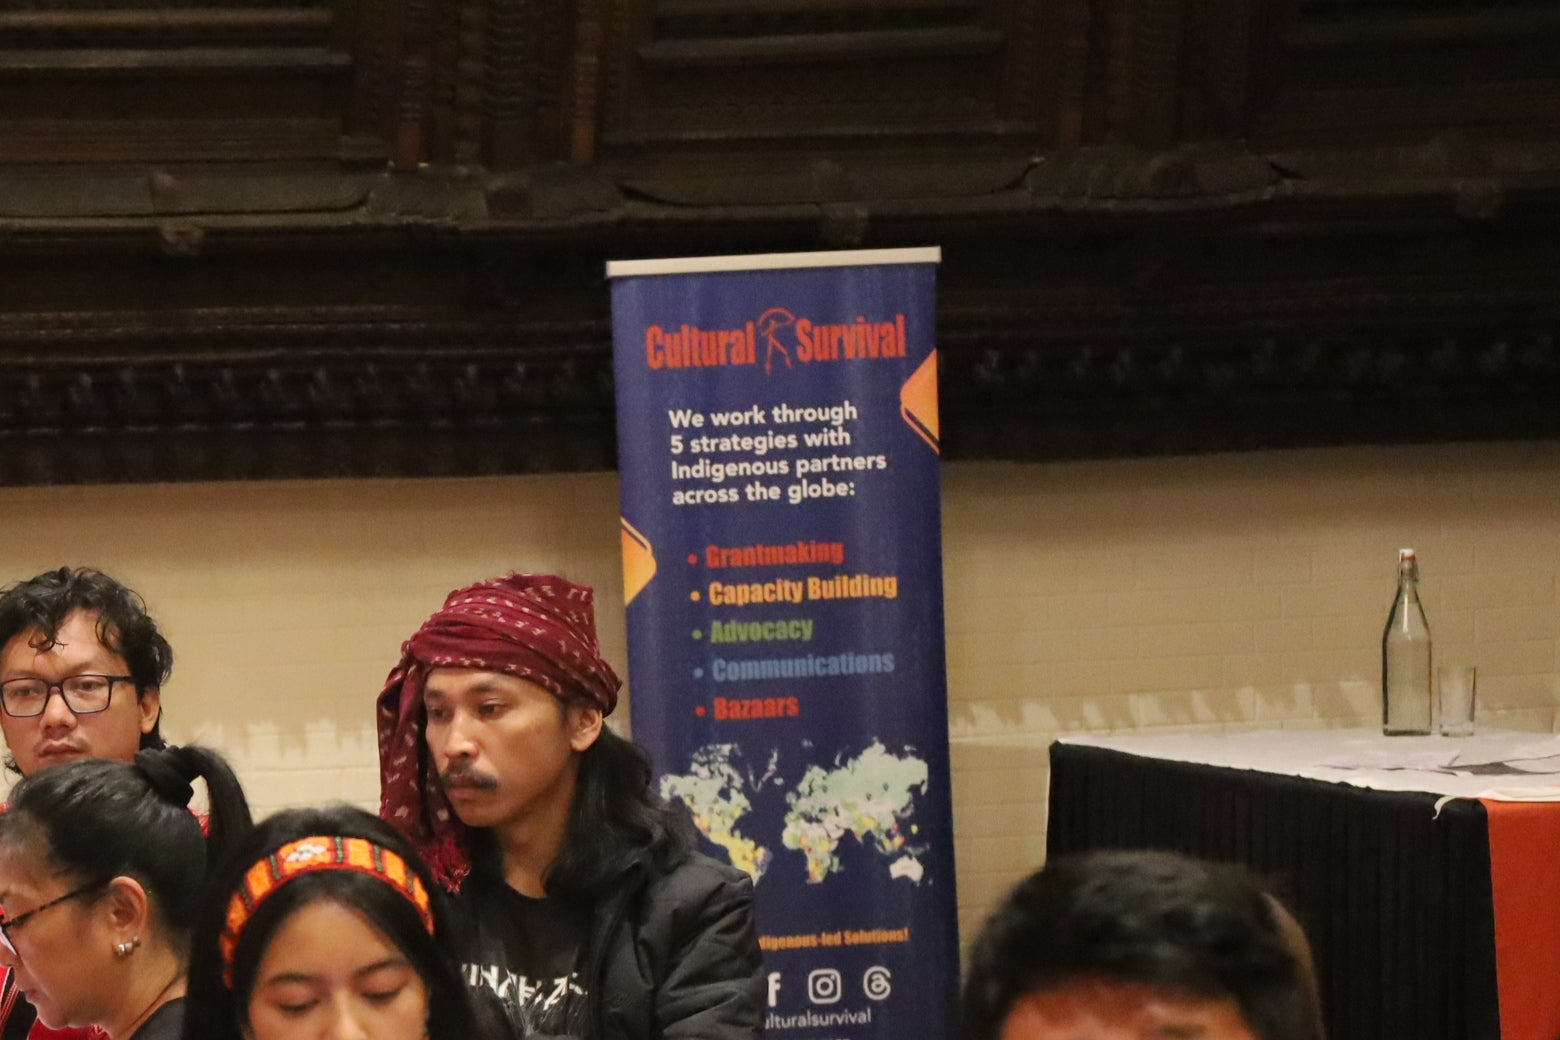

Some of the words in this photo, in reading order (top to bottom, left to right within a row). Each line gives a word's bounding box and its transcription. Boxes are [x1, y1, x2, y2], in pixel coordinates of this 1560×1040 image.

[646, 321, 757, 370] Cultural
[796, 313, 907, 363] Survival
[668, 409, 705, 428] We
[710, 404, 767, 426] work
[772, 400, 858, 426] through
[670, 435, 684, 454] 5
[690, 430, 798, 455] strategies
[804, 426, 851, 447] with
[671, 458, 790, 483] Indigenous
[796, 454, 888, 478] partners
[672, 487, 740, 505] across
[745, 480, 781, 501] the
[788, 477, 856, 504] globe:
[706, 540, 845, 568] Grantmaking
[709, 579, 803, 606] Capacity
[807, 574, 898, 600] Building
[711, 618, 814, 643] Advocacy
[712, 651, 896, 681] Communications
[714, 696, 800, 721] Bazaars
